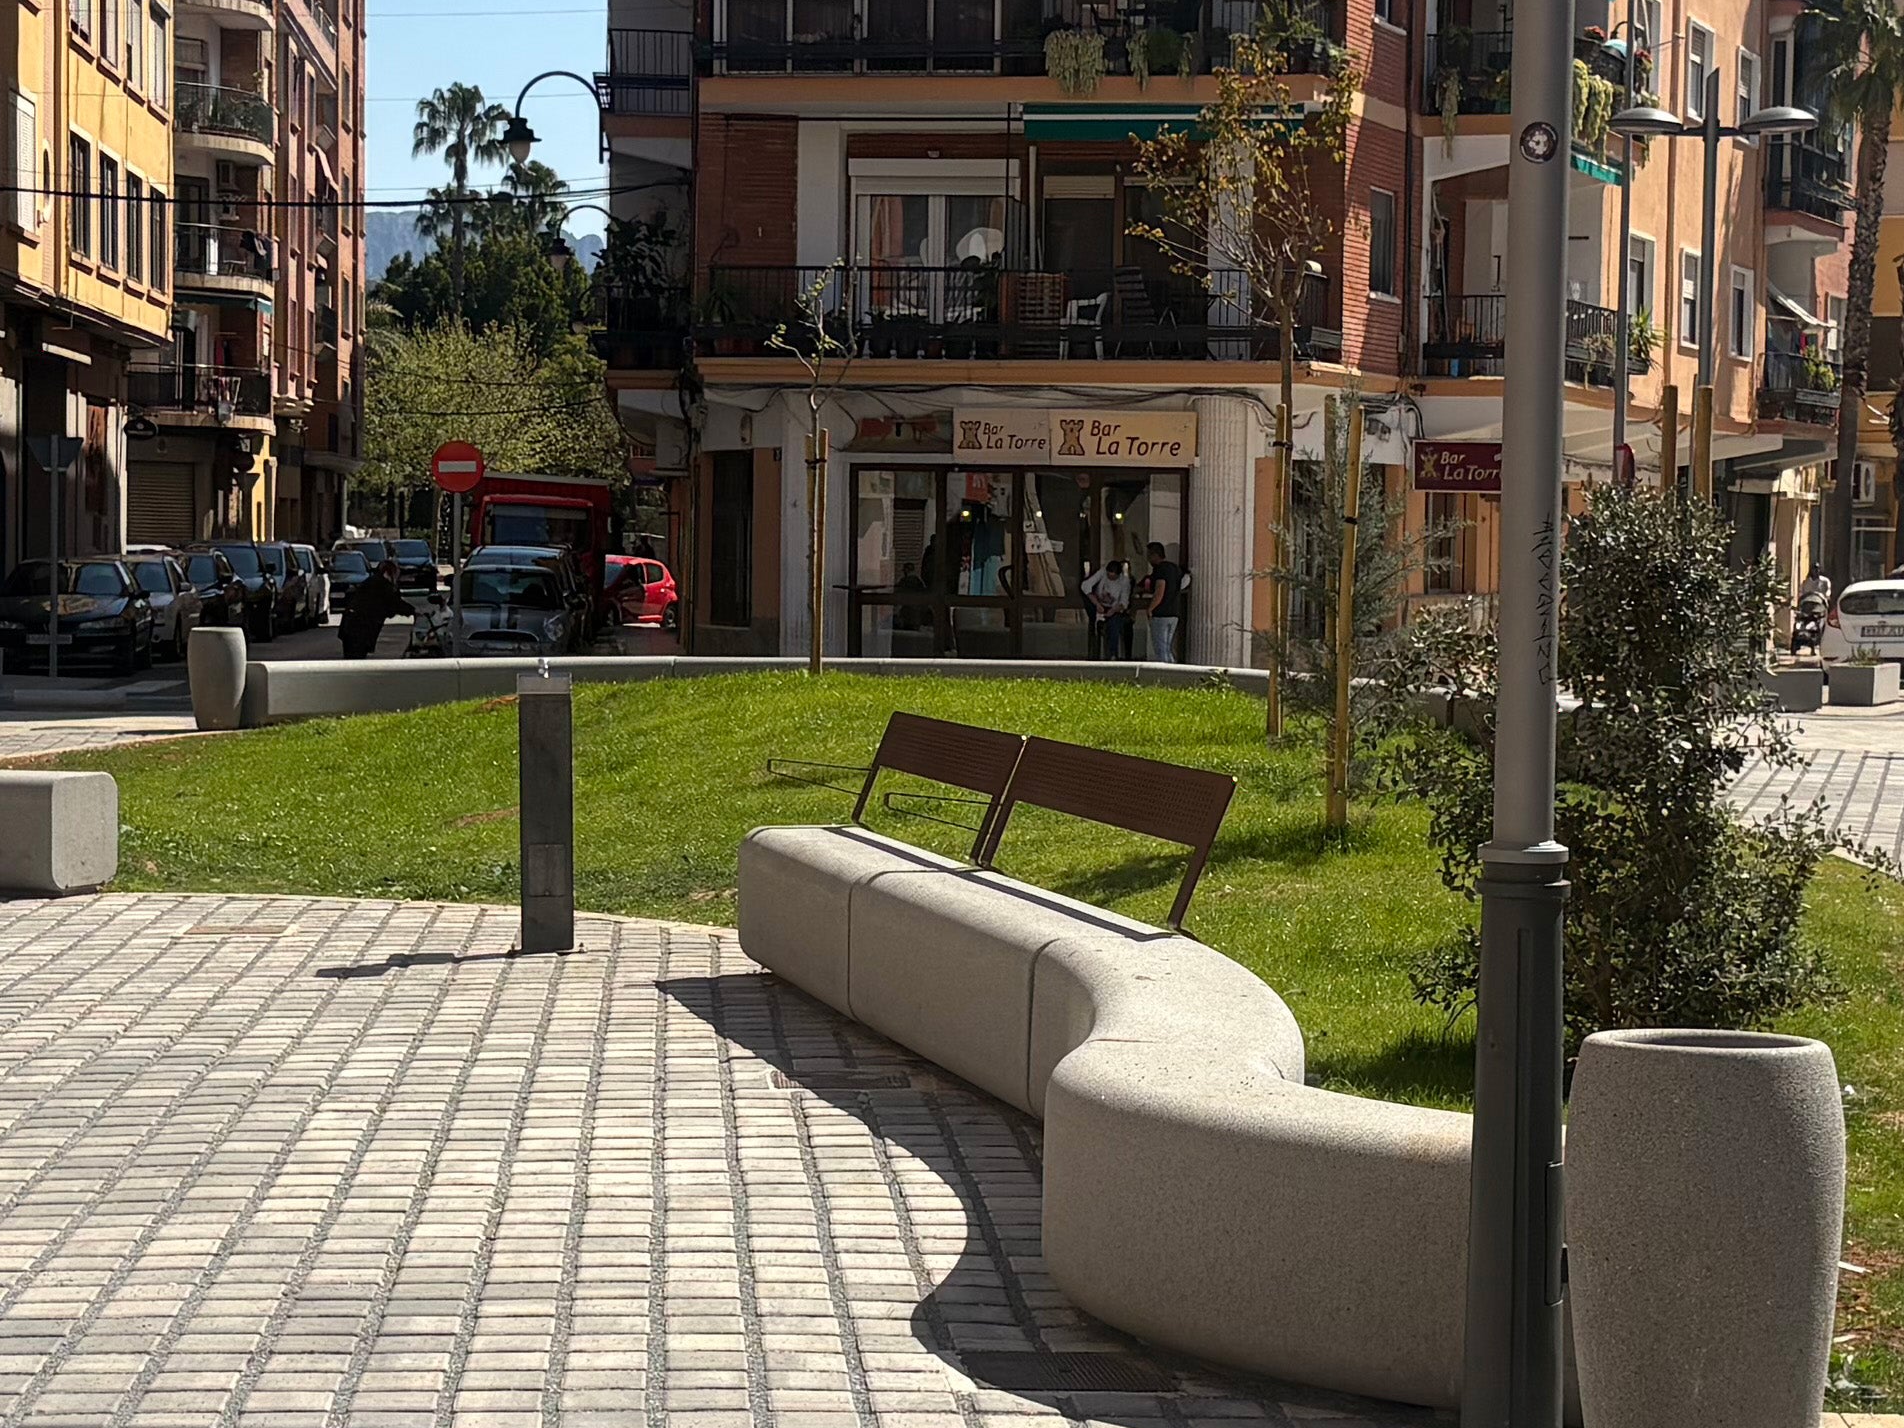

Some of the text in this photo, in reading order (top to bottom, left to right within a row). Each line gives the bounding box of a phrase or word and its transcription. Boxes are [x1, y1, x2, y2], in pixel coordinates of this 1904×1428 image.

[983, 422, 1004, 436] Bar
[1090, 420, 1121, 437] Bar
[986, 434, 1046, 450] La Torre
[1095, 436, 1181, 457] La Torre
[1440, 451, 1466, 465] Bar
[1443, 465, 1502, 481] La Torr
